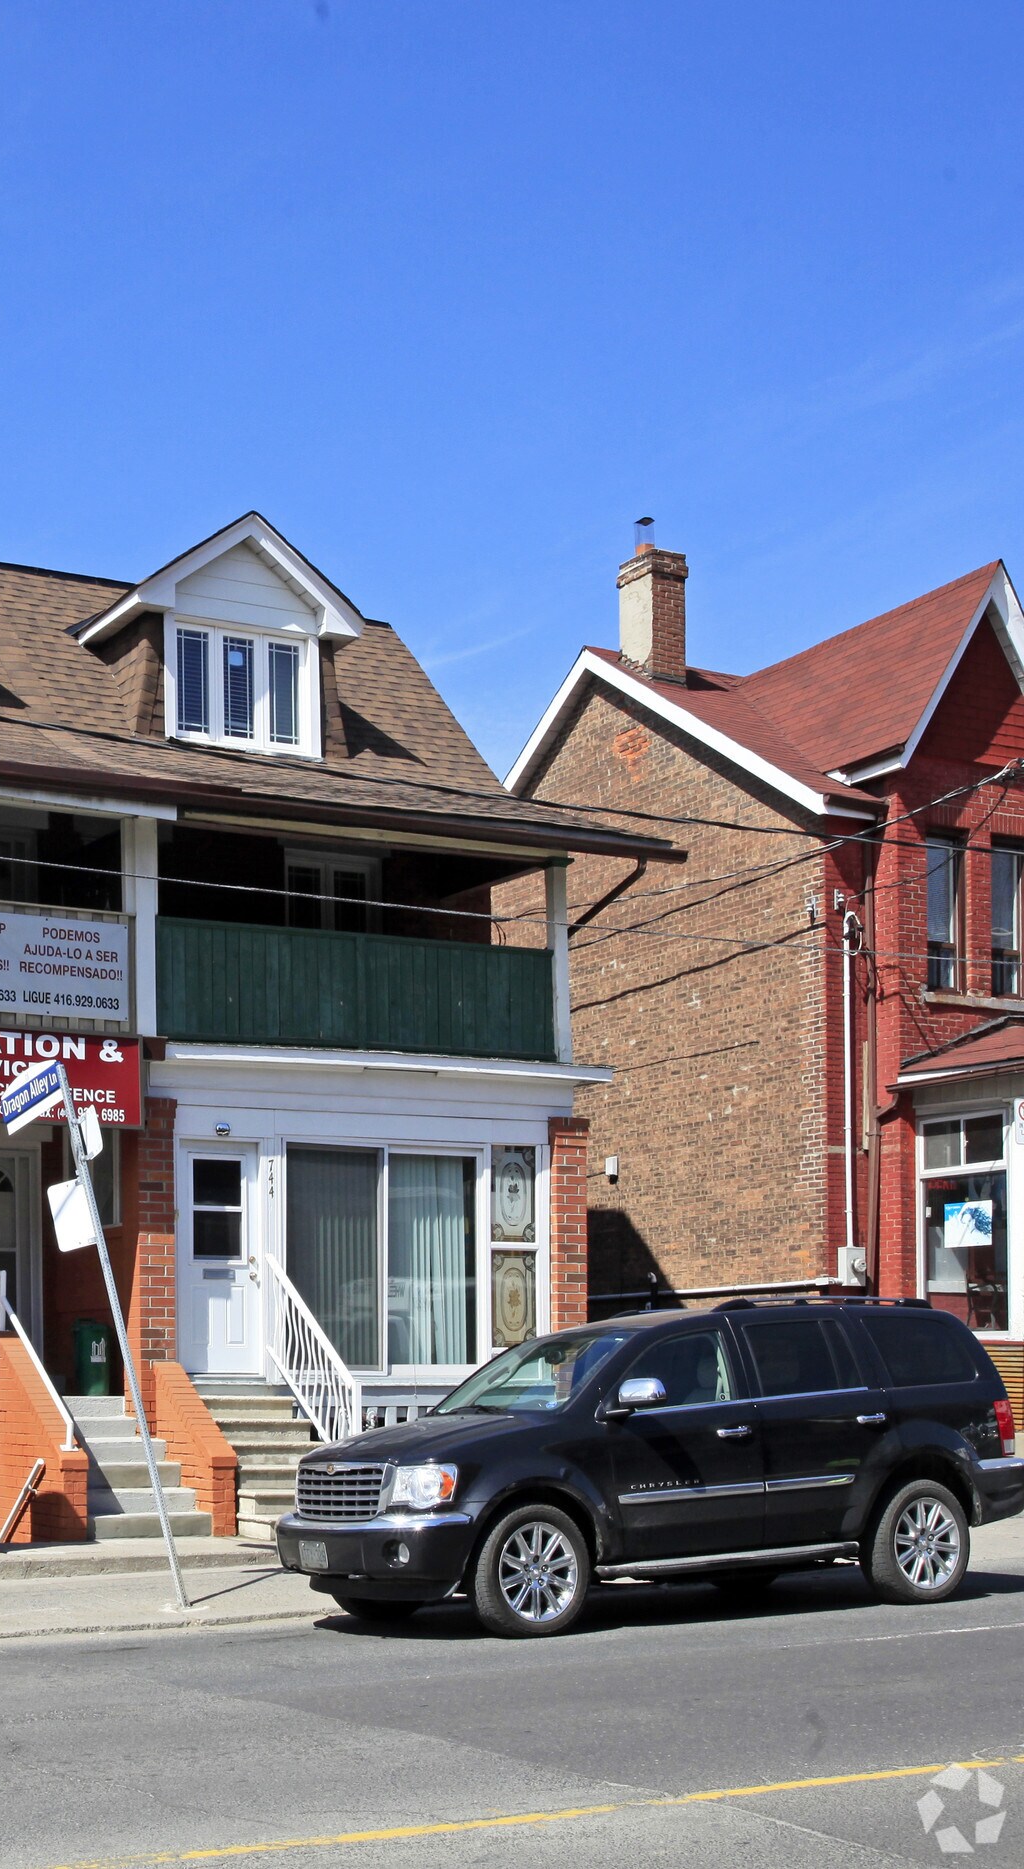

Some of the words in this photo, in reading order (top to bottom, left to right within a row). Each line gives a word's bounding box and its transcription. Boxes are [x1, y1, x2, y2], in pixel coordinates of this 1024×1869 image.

[42, 927, 101, 943] PODEMOS
[23, 943, 82, 959] AJUDA-LO
[85, 947, 94, 960] A
[97, 948, 119, 963] SER
[19, 960, 123, 981] RECOMPENSADO!!
[22, 990, 51, 1005] LIGUE
[53, 992, 120, 1010] 416.929.0633
[99, 1039, 124, 1063] &
[2, 1090, 31, 1117] Dragon
[29, 1076, 49, 1097] Alley
[49, 1072, 58, 1086] Ln
[101, 1107, 125, 1122] 6985
[630, 1479, 700, 1490] CHRYSLER
